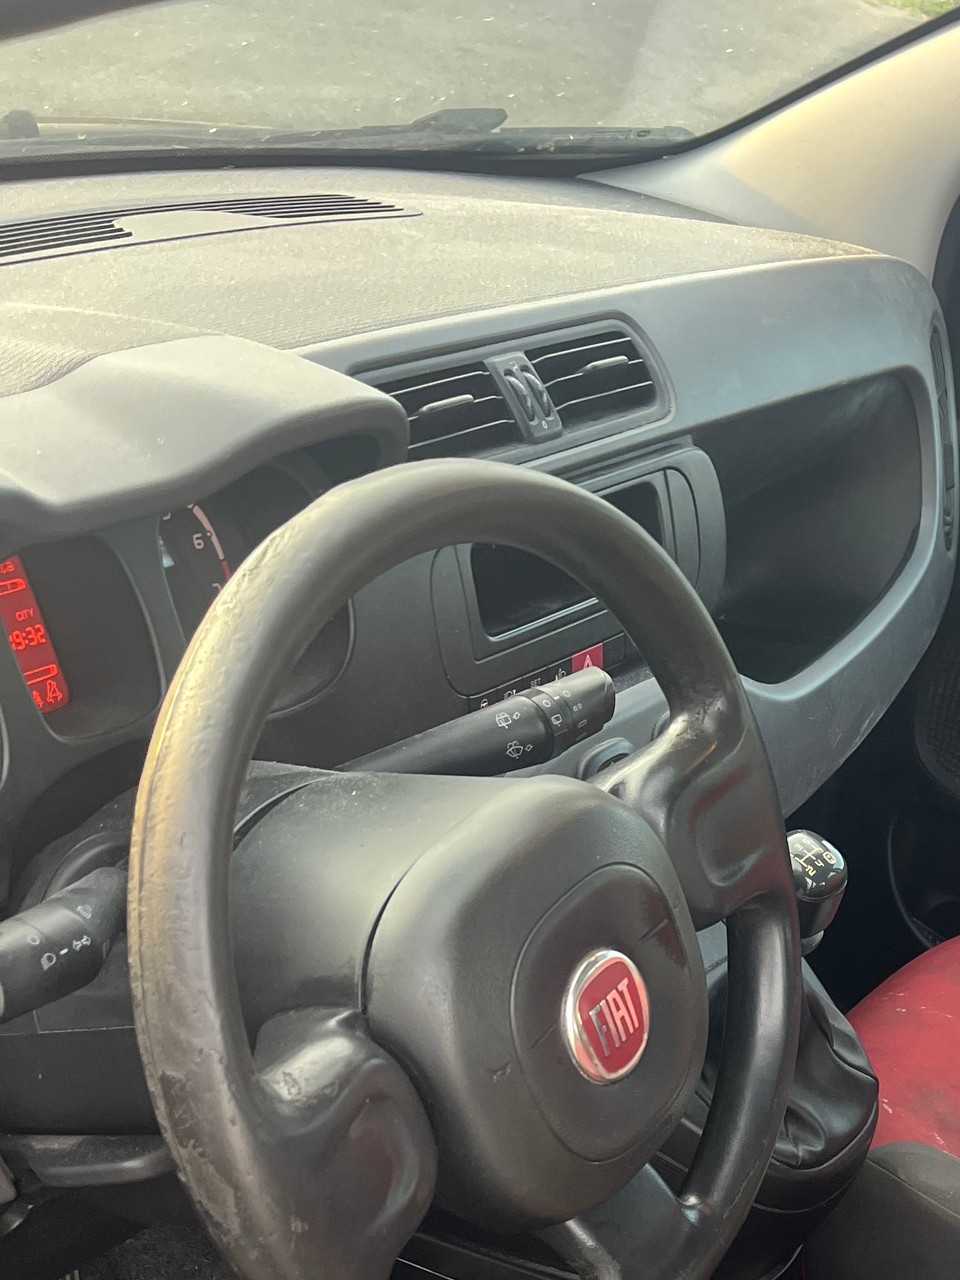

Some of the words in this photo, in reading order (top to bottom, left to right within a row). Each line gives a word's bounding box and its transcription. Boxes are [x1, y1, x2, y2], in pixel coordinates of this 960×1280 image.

[193, 533, 204, 550] 6
[16, 608, 34, 622] CITY
[589, 977, 640, 1057] FIAT
